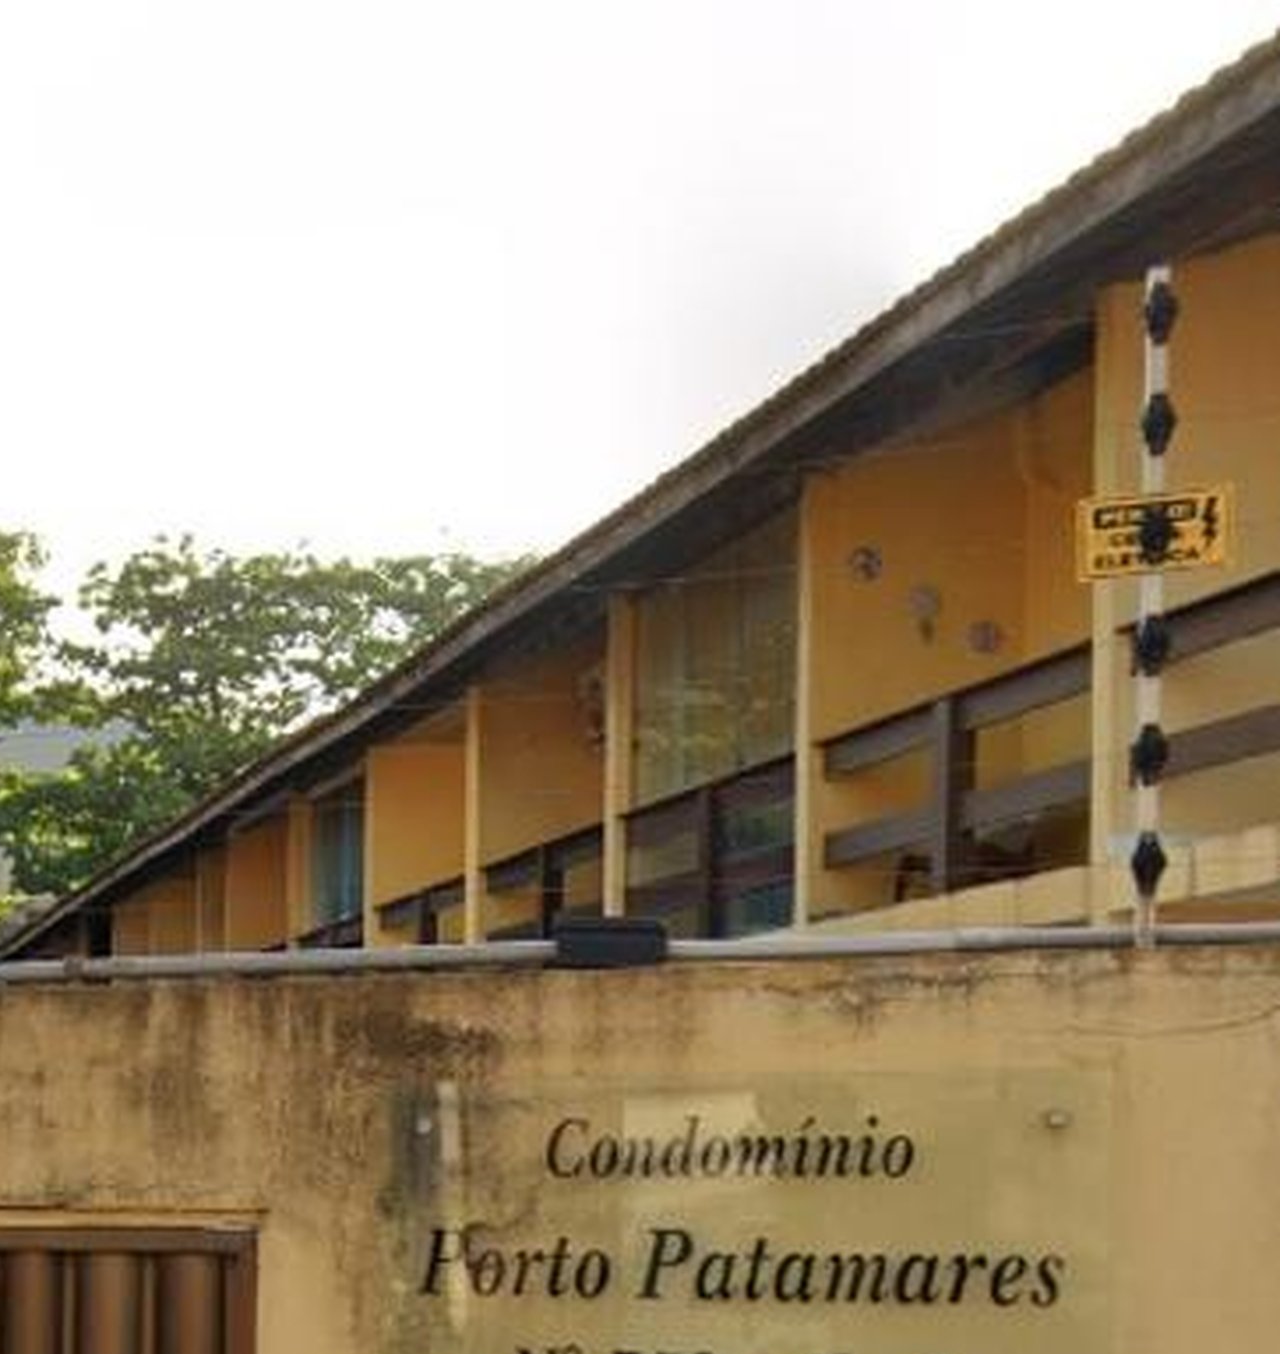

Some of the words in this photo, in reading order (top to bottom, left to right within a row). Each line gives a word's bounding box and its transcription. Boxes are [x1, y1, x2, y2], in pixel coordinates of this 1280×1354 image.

[545, 1114, 914, 1180] Condomínio
[418, 1227, 611, 1300] Porto
[637, 1228, 1066, 1308] Patamares
